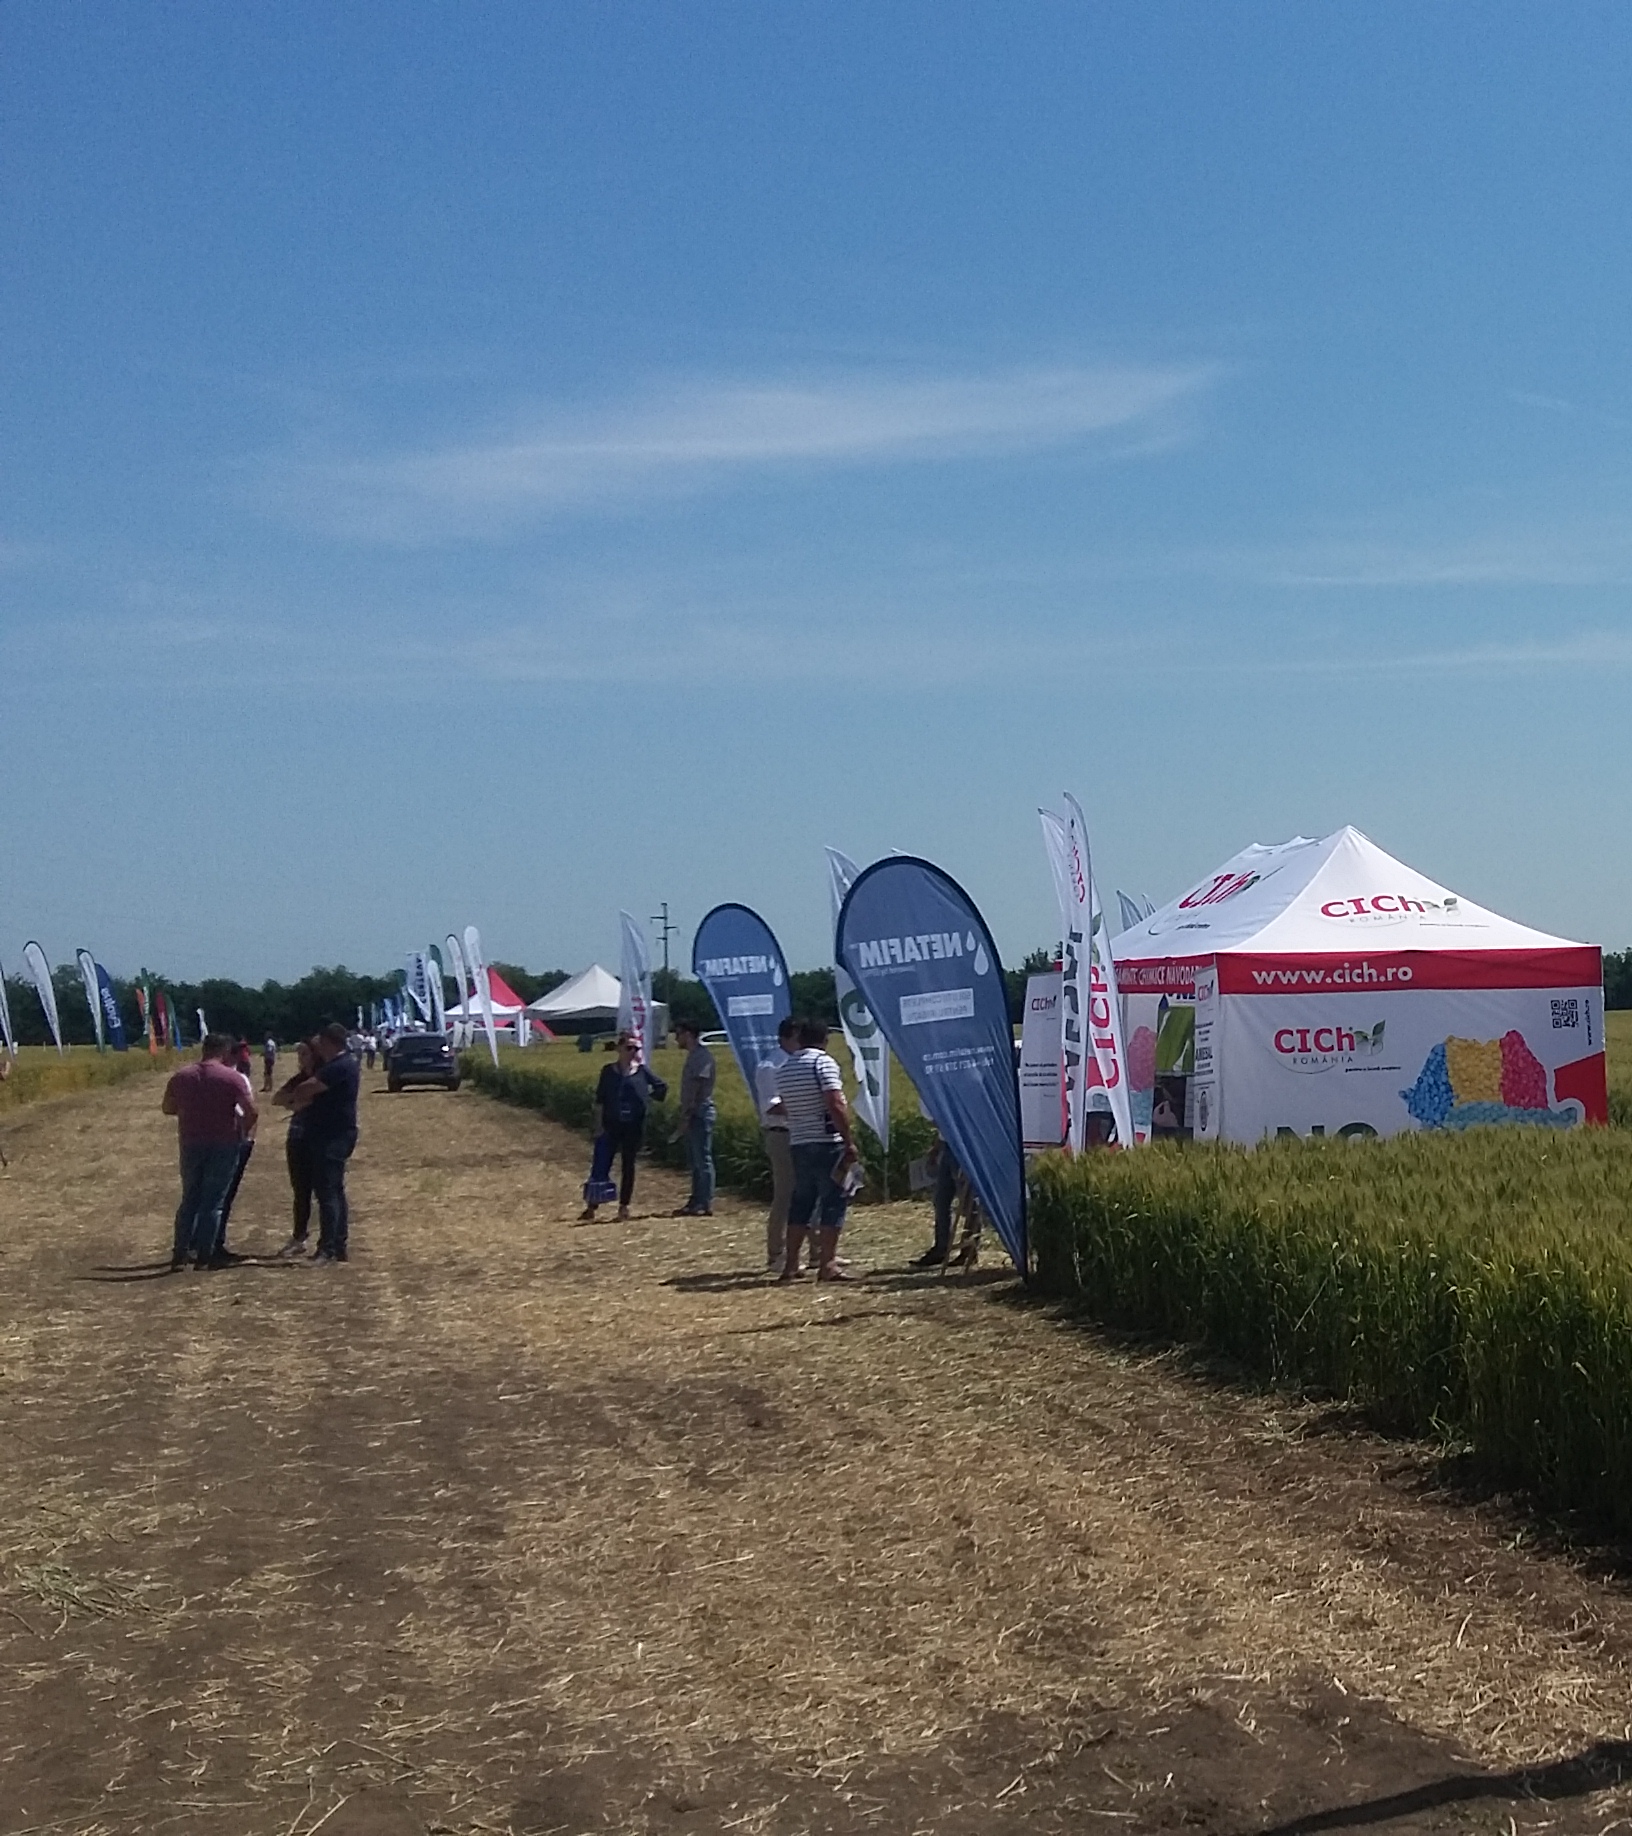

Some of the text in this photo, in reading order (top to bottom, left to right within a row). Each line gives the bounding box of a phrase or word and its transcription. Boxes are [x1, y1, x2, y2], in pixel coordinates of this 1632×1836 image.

[1320, 894, 1426, 918] CICh
[1252, 961, 1413, 986] www.cich.ro
[1273, 1027, 1357, 1054] CICh
[1292, 1055, 1355, 1066] ROMÂNIA
